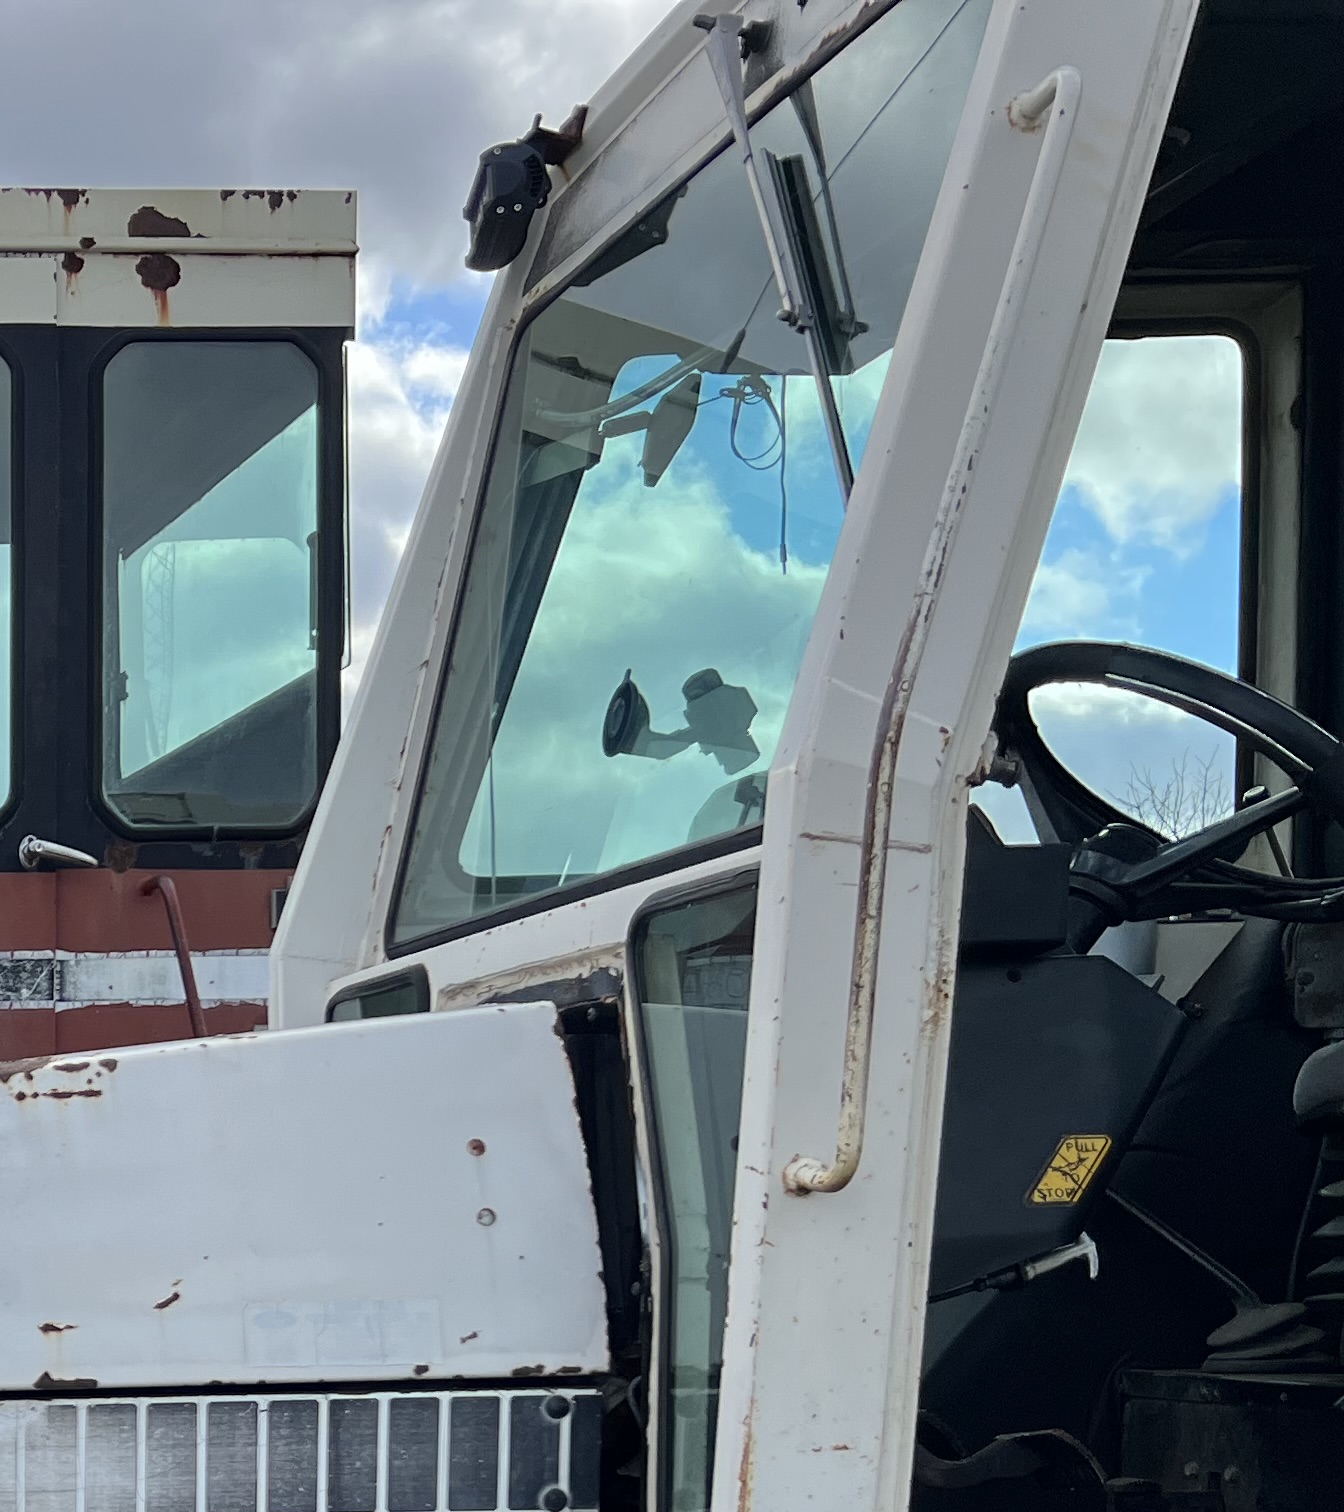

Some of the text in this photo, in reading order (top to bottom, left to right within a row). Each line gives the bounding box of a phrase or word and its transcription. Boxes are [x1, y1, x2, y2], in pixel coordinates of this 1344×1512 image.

[1065, 1141, 1098, 1153] PULL
[1062, 1172, 1080, 1183] TO
[1037, 1187, 1075, 1199] STOP
